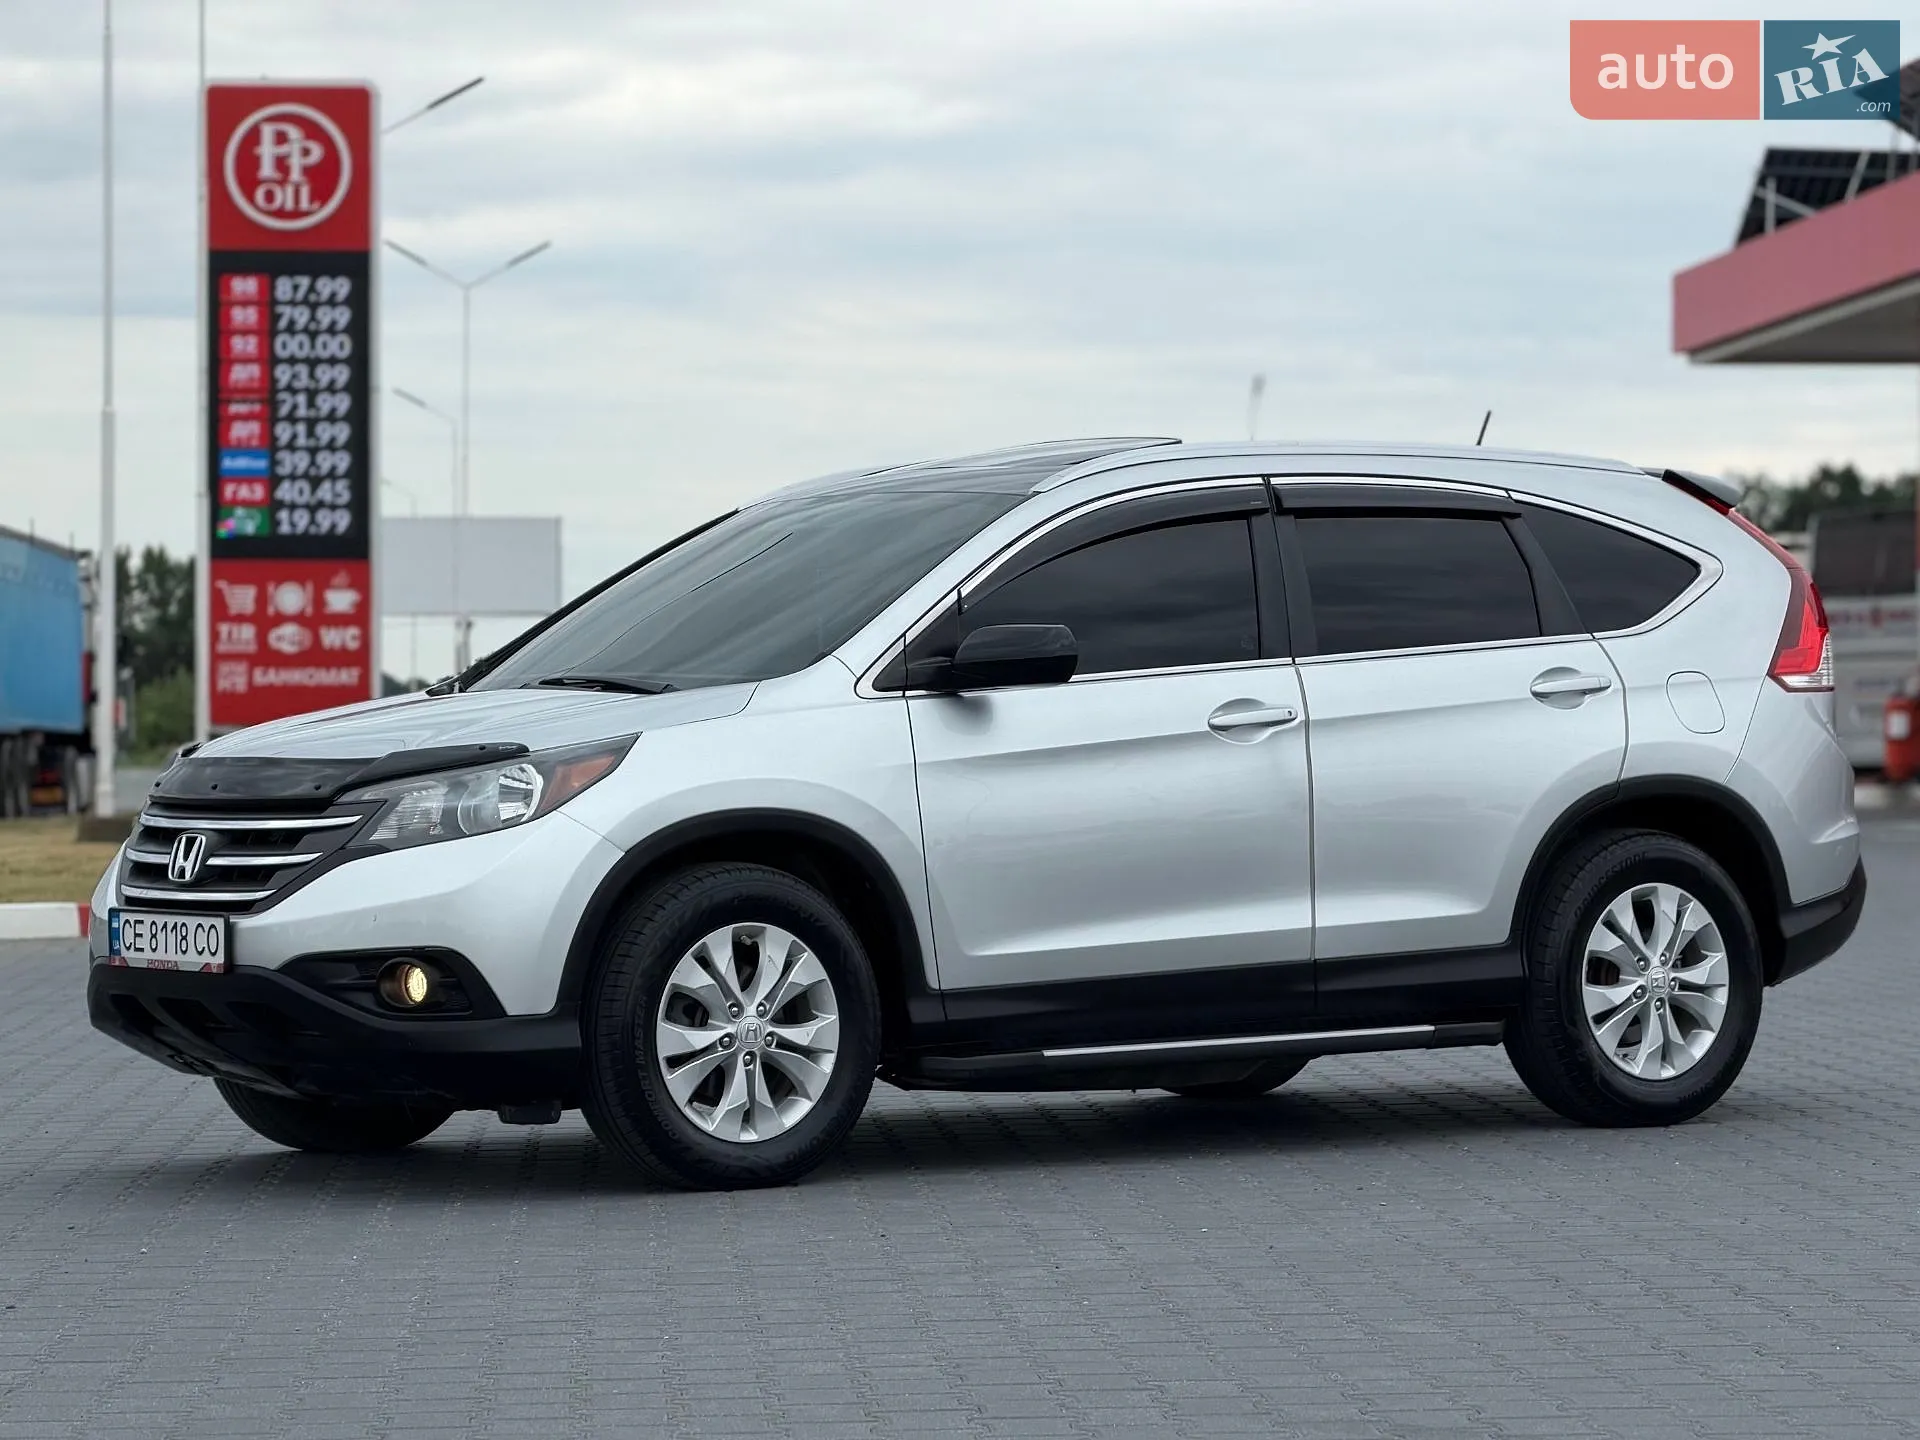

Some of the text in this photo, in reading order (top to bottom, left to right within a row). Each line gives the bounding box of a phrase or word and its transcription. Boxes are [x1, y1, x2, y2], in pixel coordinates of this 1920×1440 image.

[254, 182, 321, 213] OIL
[274, 275, 352, 302] 87.99
[274, 304, 352, 331] 79.99
[273, 333, 352, 359] 00.00
[273, 362, 352, 390] 93.99
[273, 420, 352, 447] 91.99
[274, 449, 352, 476] 39.99
[273, 478, 352, 505] 40.45
[275, 507, 352, 535] 19.99
[319, 625, 361, 651] WC
[122, 918, 219, 956] CE 8118 CO
